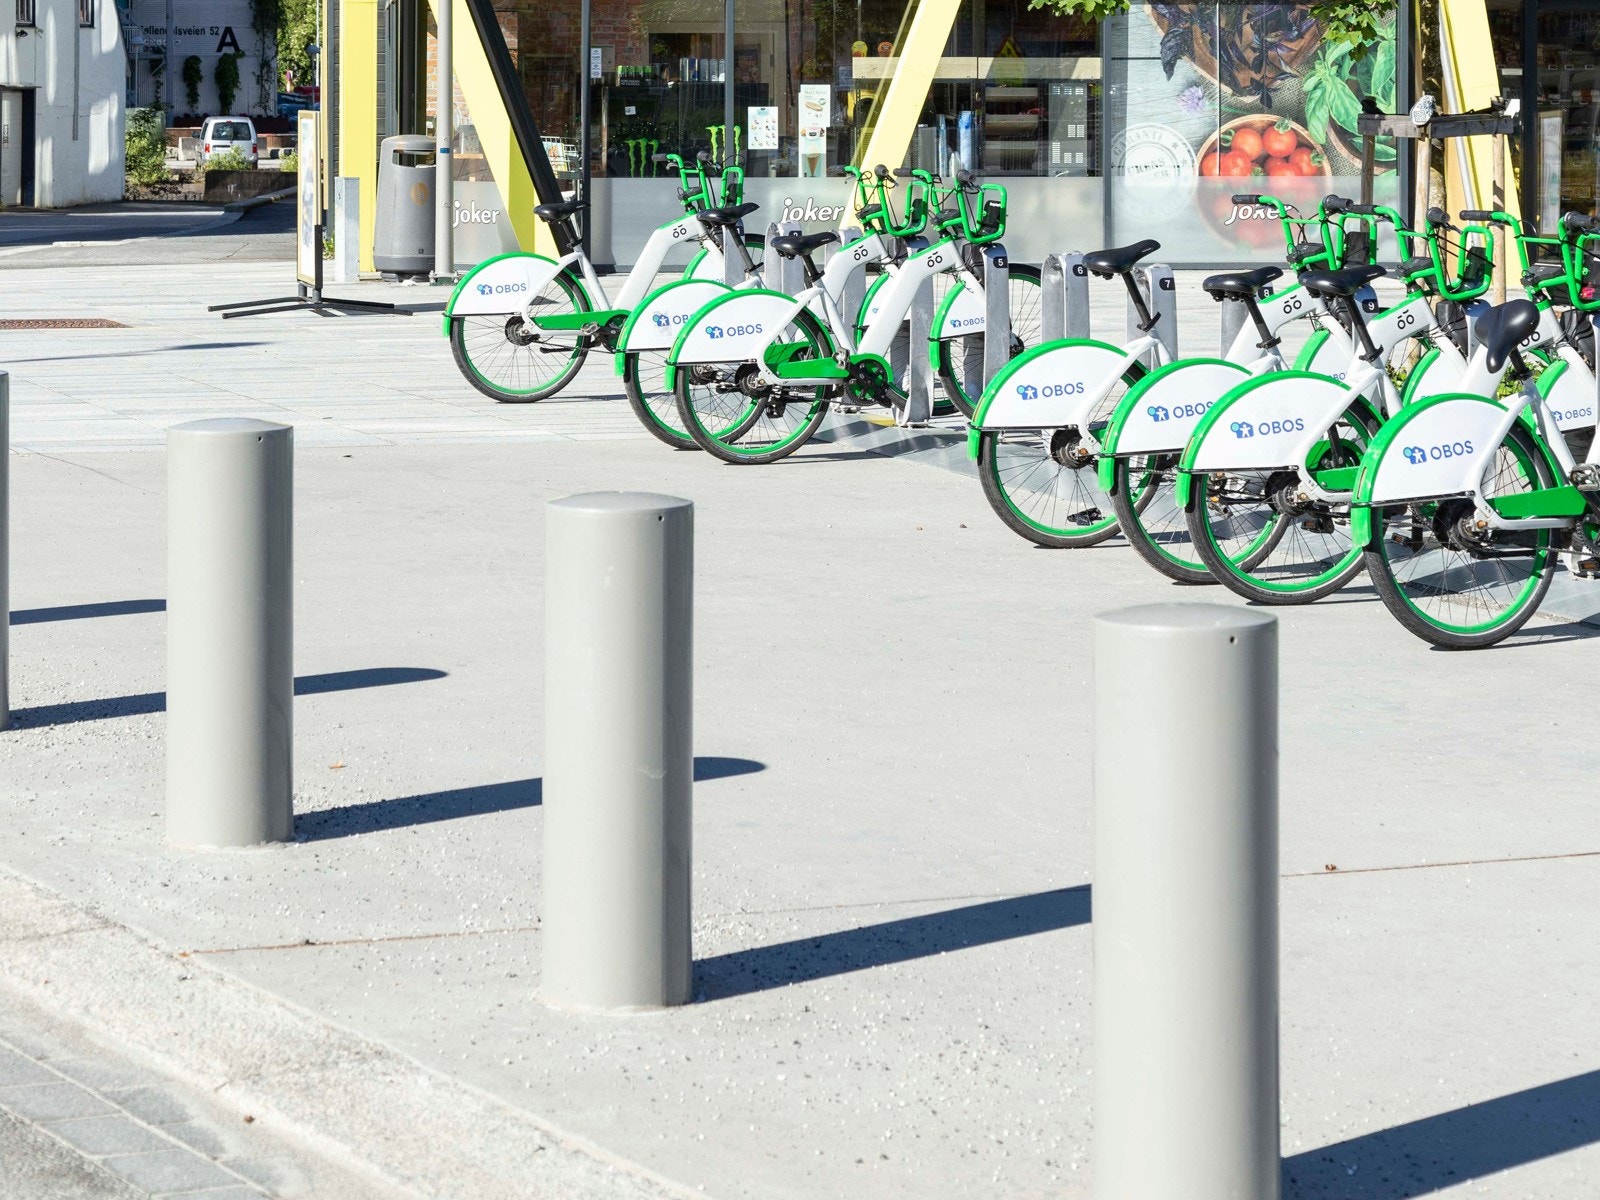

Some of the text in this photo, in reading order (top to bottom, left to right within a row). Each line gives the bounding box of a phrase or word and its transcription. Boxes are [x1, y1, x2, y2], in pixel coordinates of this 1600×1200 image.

[209, 26, 219, 36] 52
[216, 26, 241, 53] A
[452, 199, 500, 228] joker
[781, 197, 845, 223] joker
[997, 258, 1004, 267] 5
[1077, 266, 1084, 275] 6
[495, 283, 527, 294] OBOS
[1164, 279, 1171, 288] 7
[1263, 288, 1270, 298] 8
[1368, 301, 1375, 311] 9
[672, 313, 694, 325] OB
[963, 316, 985, 327] OBOS
[726, 323, 763, 336] OBOS
[1042, 382, 1084, 397] OBOS
[1565, 407, 1592, 420] OBOS
[1258, 418, 1304, 435] OBOS
[1430, 440, 1474, 461] OBOS
